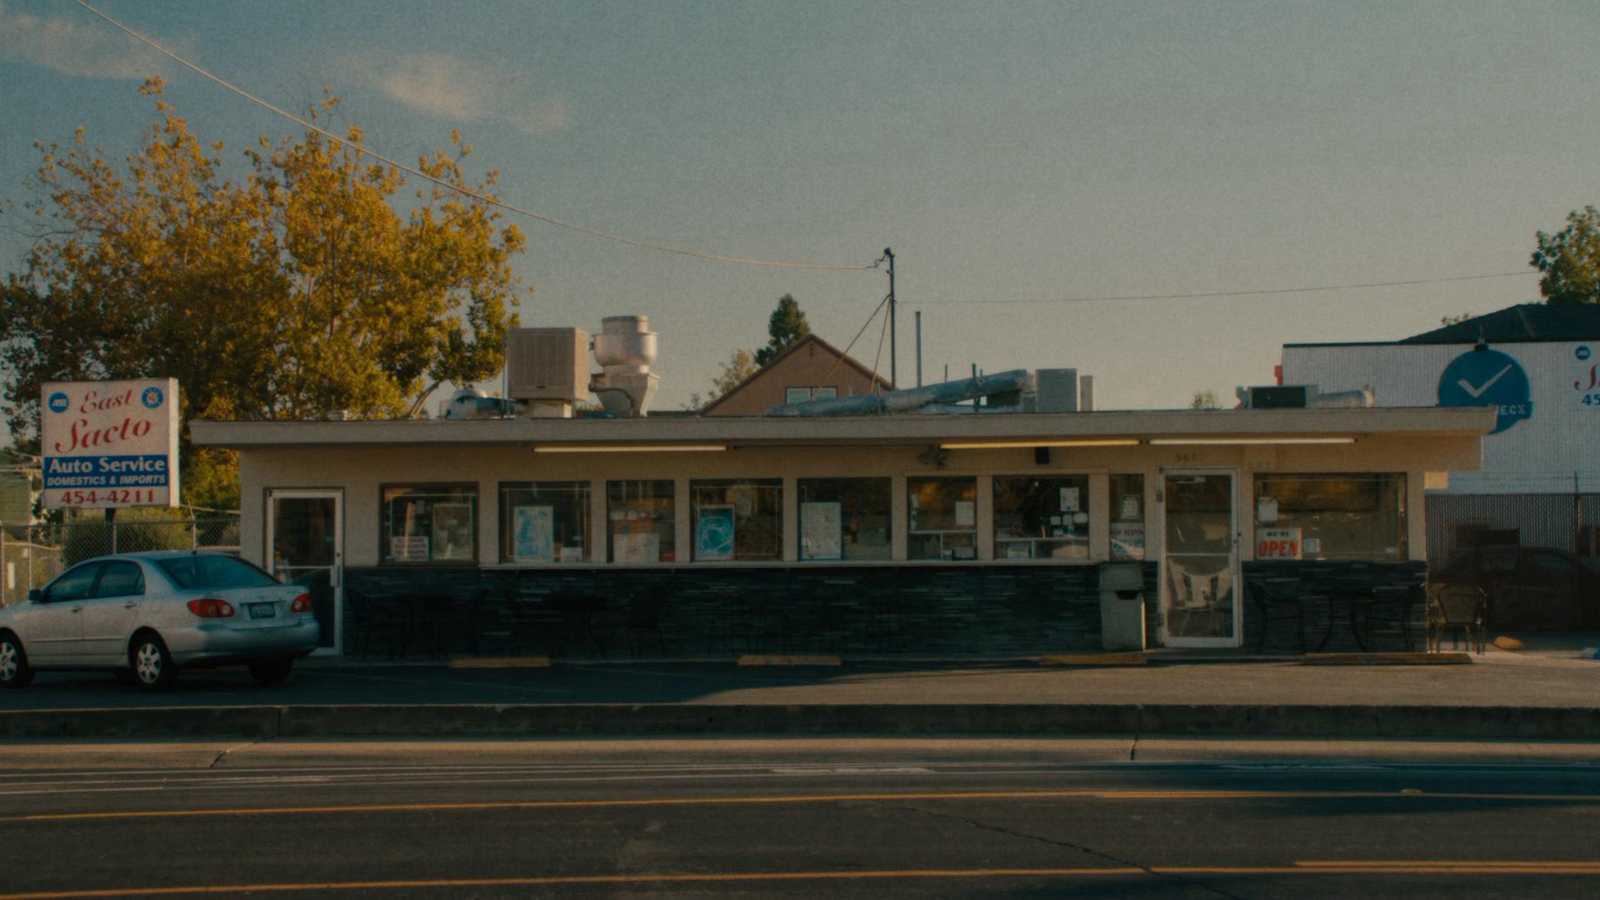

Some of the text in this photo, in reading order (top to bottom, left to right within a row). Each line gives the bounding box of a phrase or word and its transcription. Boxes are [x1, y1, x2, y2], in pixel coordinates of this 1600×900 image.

[80, 389, 133, 414] East
[55, 417, 151, 453] Sacto
[48, 456, 166, 473] Auto Service
[47, 474, 166, 486] DOMESTICS & IMPORTS
[61, 489, 155, 504] 454-4211
[1258, 541, 1298, 556] OPEN
